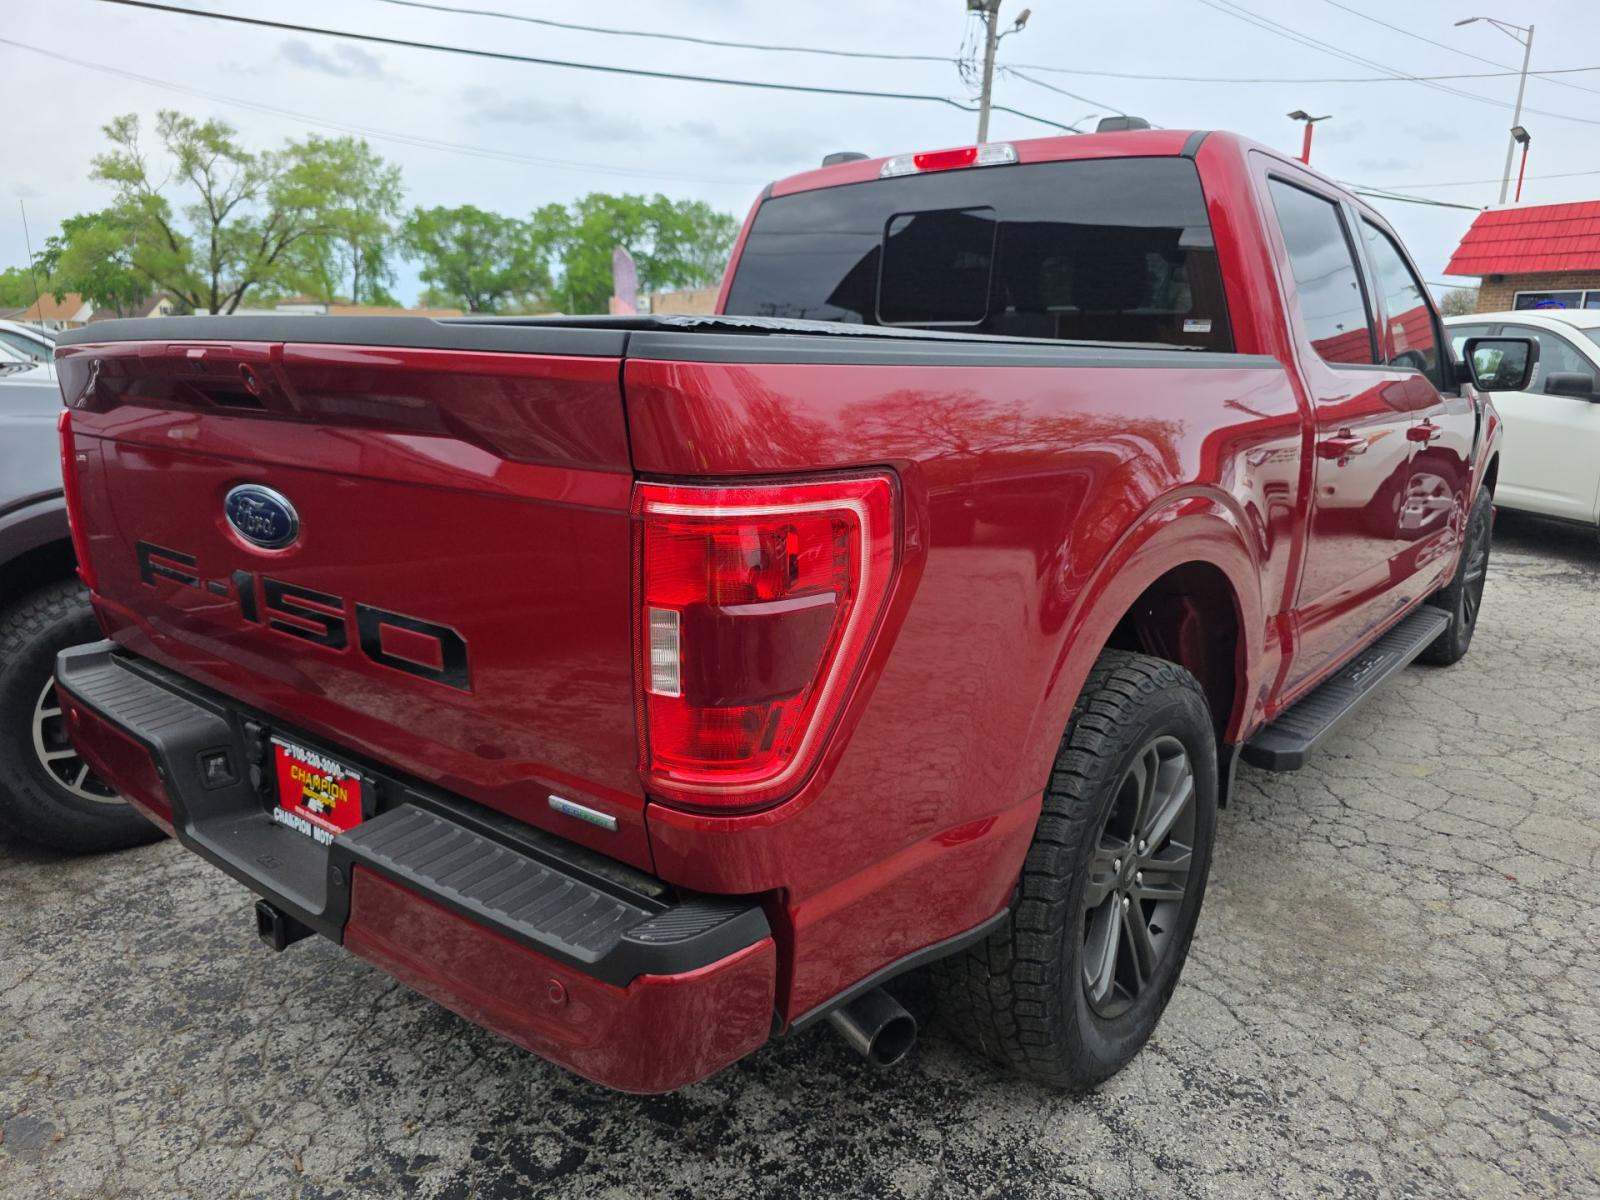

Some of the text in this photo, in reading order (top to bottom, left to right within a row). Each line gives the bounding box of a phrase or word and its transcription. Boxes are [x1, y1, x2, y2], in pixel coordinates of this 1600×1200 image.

[234, 495, 277, 536] Ford
[135, 540, 473, 691] F-150
[290, 765, 348, 802] CHAMPION
[273, 807, 312, 837] CHAMPION
